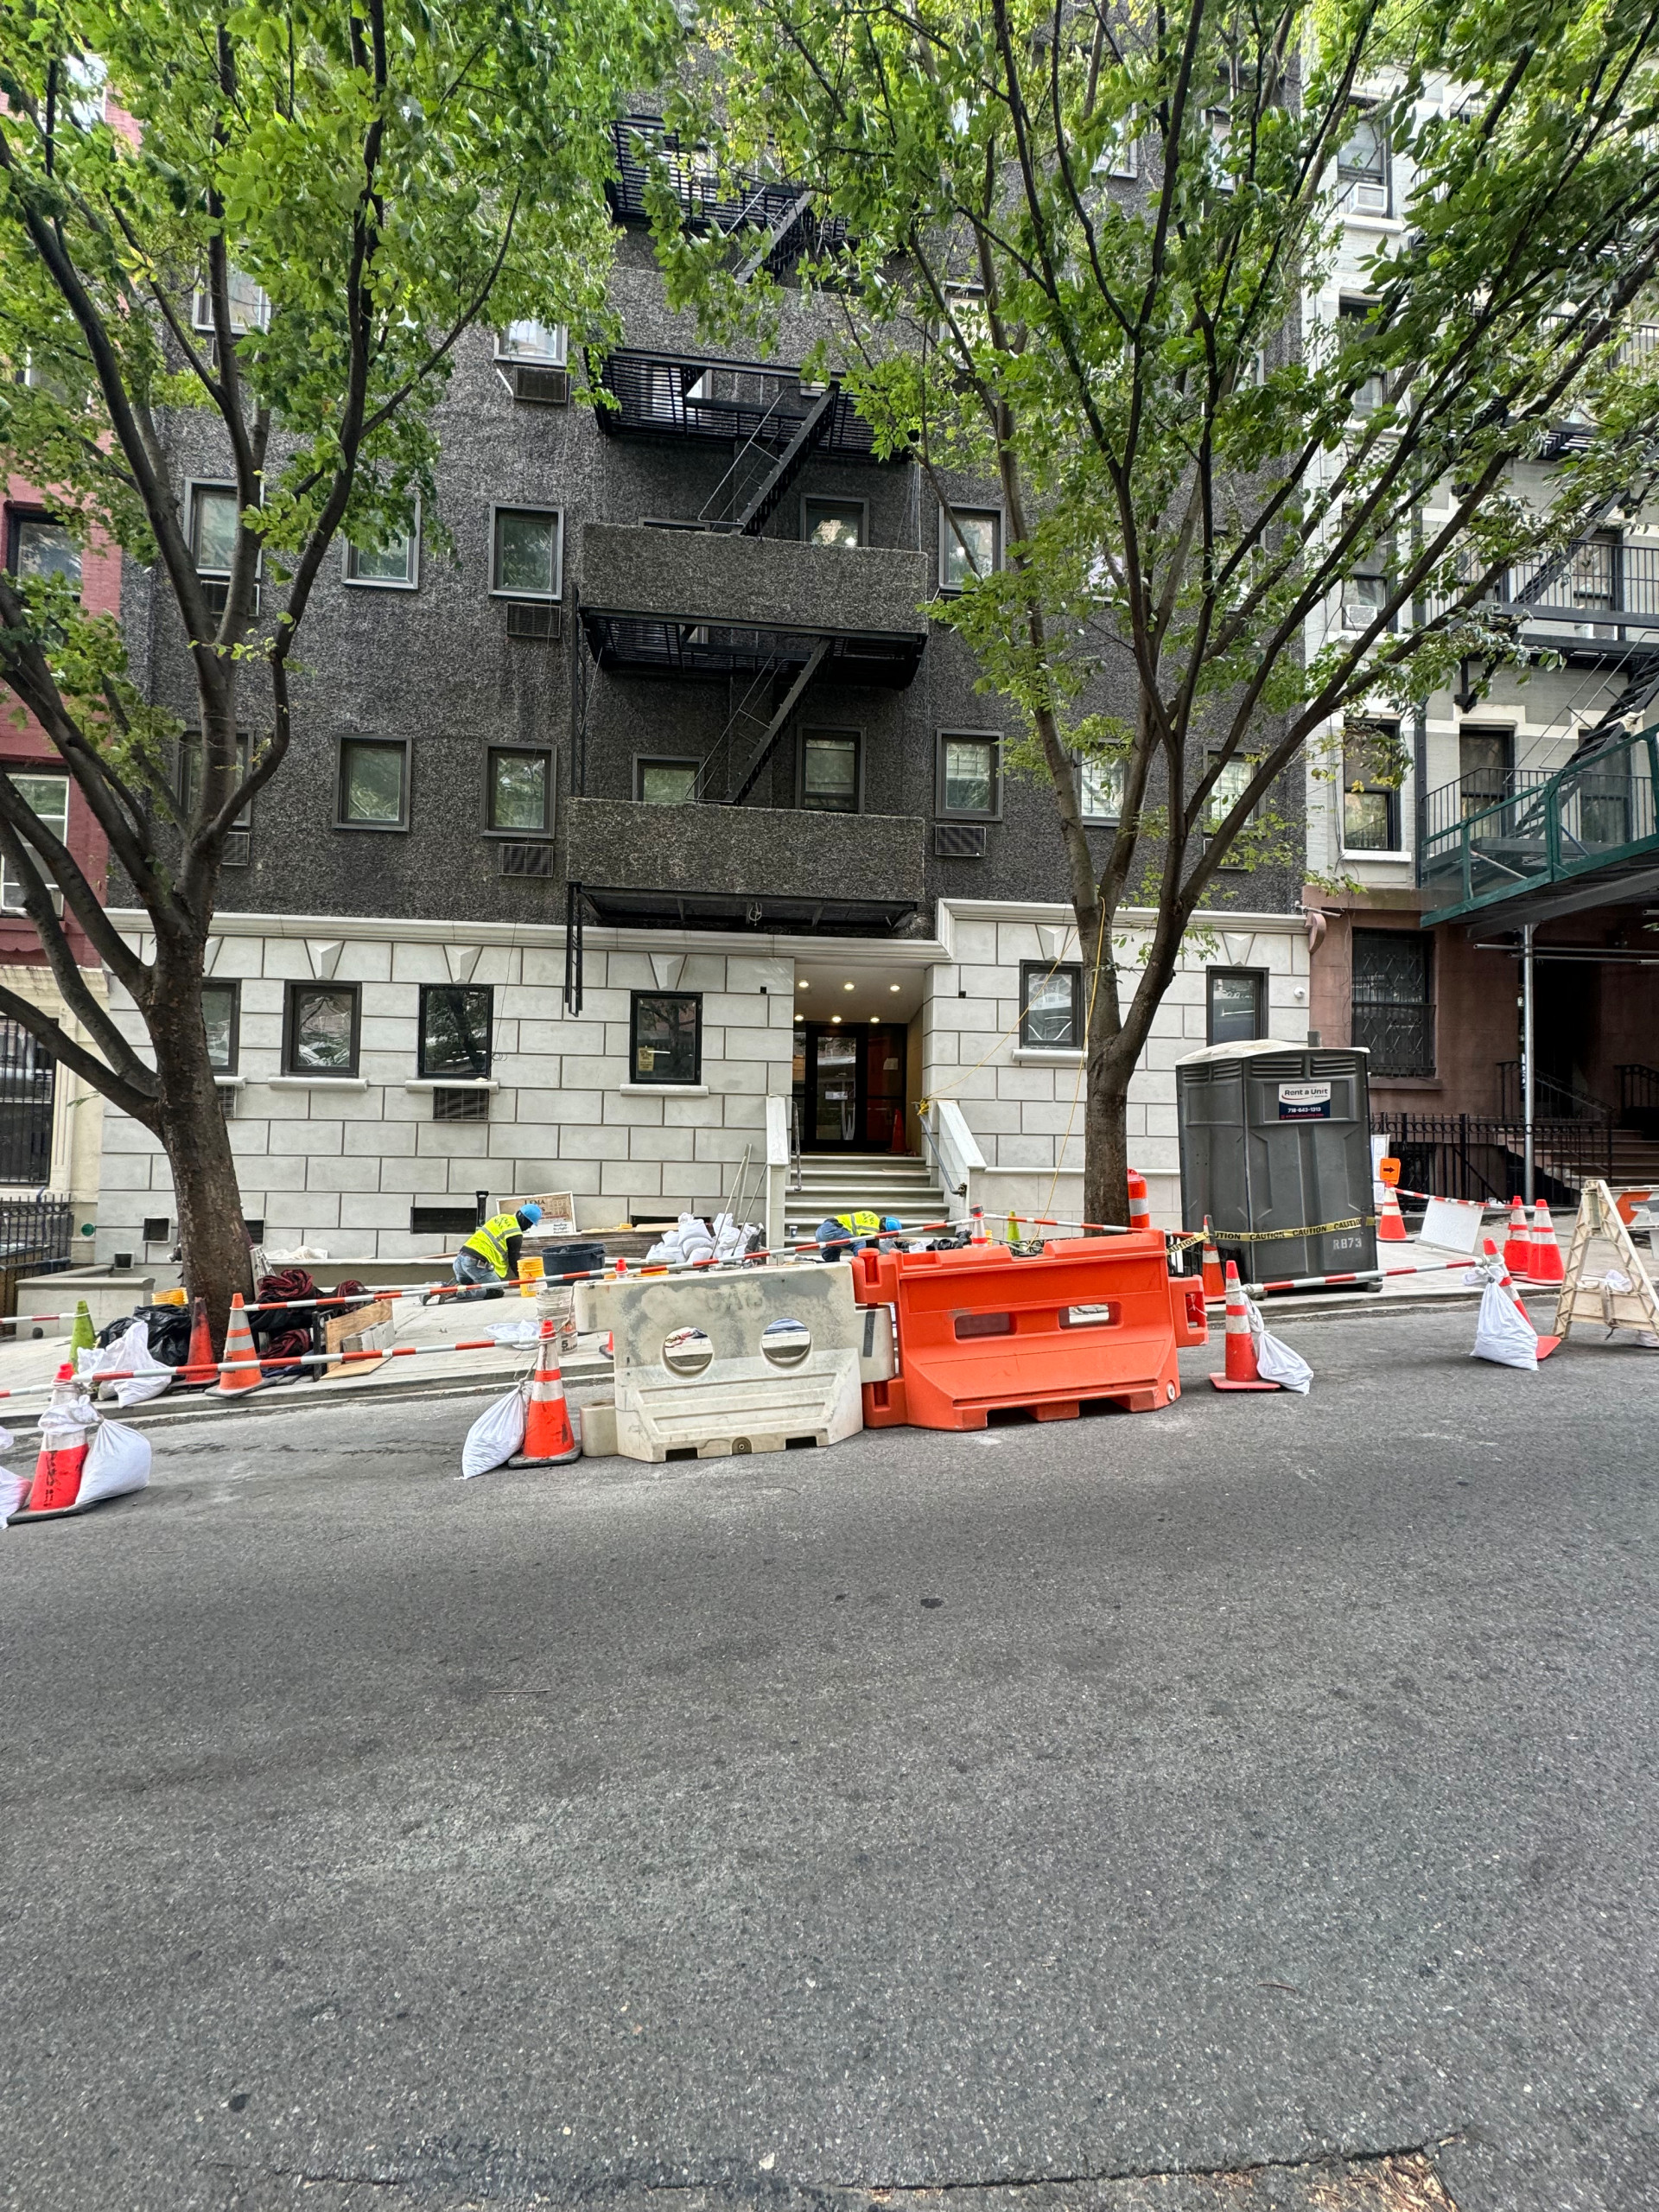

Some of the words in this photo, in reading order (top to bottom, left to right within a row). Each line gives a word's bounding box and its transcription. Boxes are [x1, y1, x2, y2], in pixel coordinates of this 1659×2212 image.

[1249, 1231, 1285, 1241] CAUTION
[1293, 1226, 1327, 1236] CAUTION
[561, 1340, 569, 1349] 5
